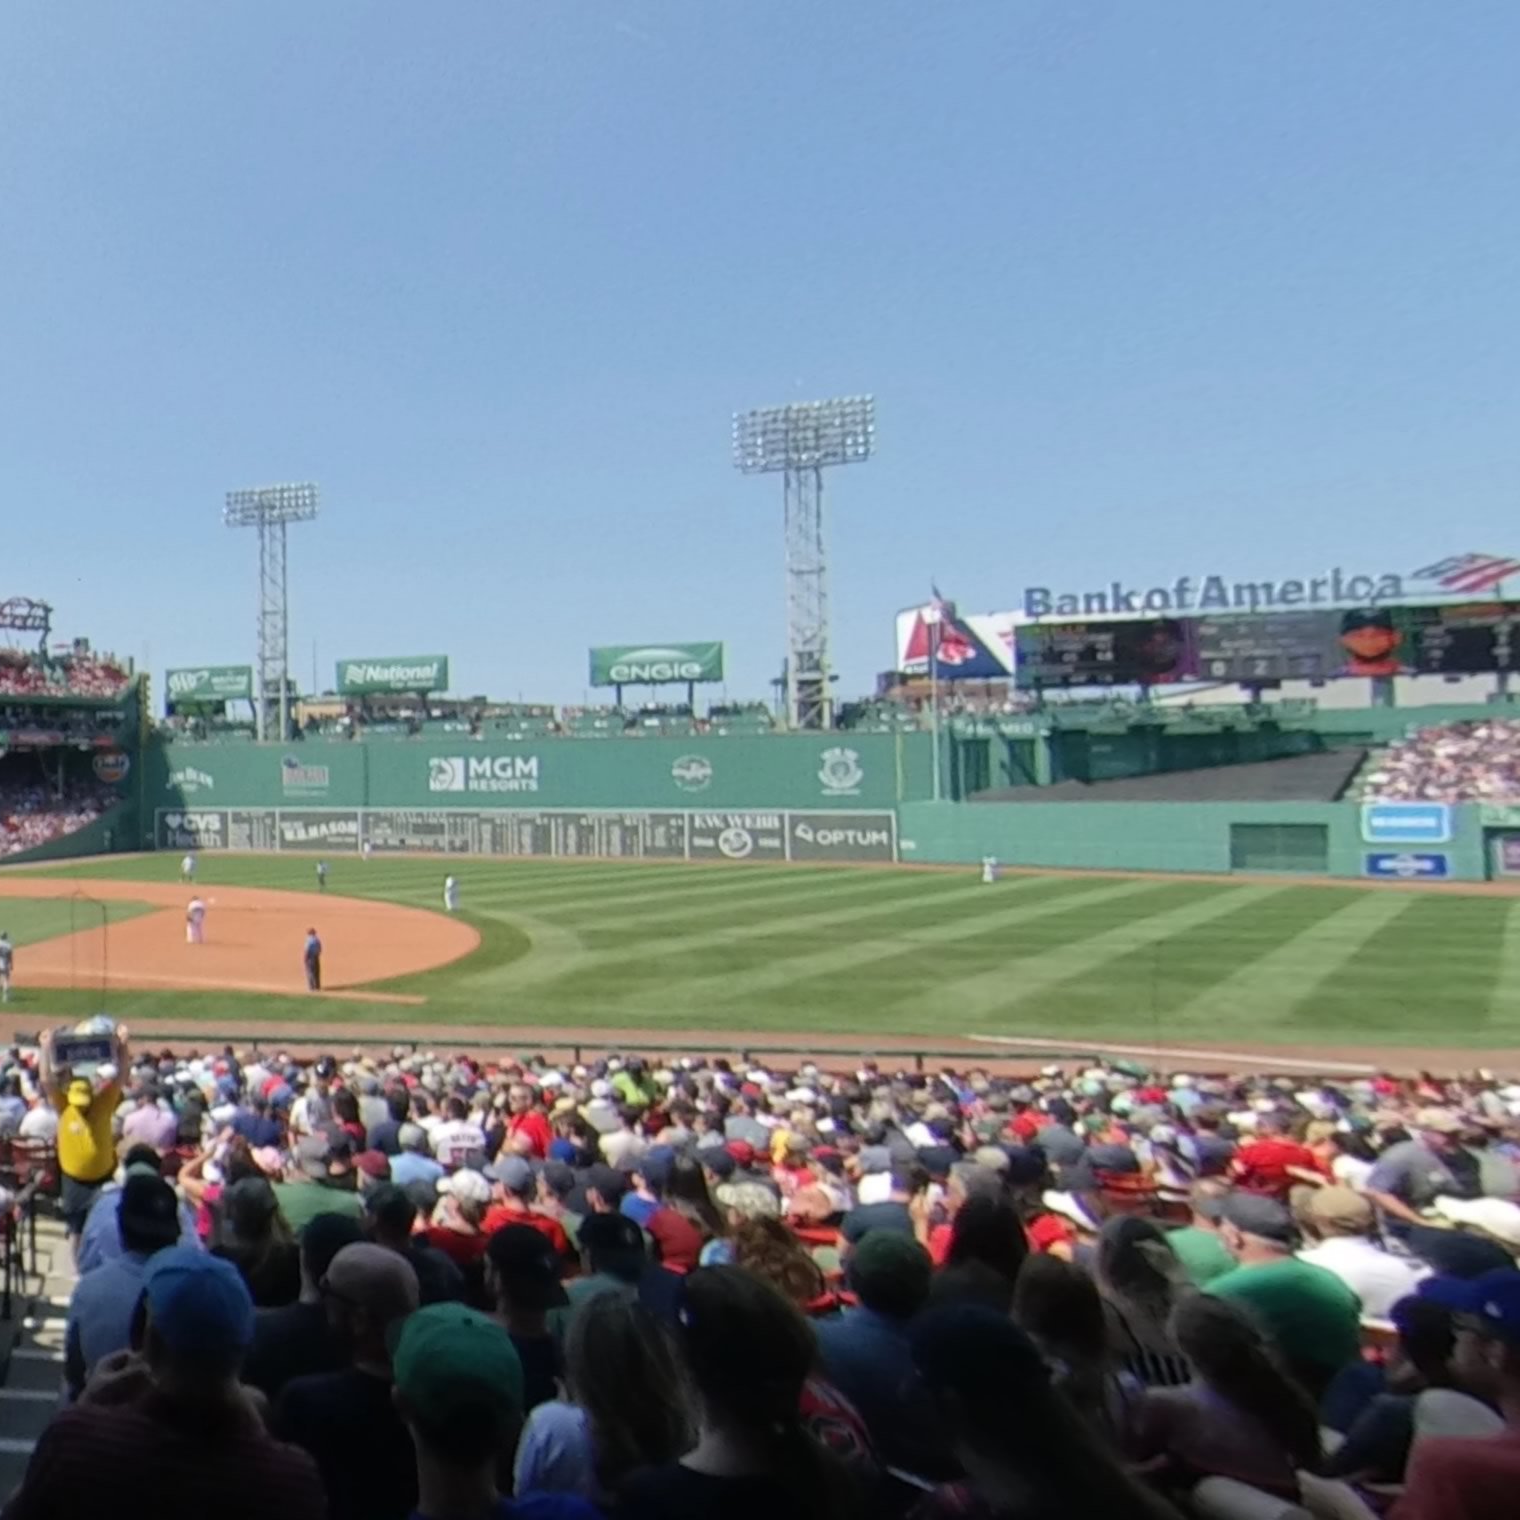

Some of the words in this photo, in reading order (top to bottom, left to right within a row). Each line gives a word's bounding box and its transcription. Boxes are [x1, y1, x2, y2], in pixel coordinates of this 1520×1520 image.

[1024, 582, 1136, 617] Bank
[1144, 577, 1191, 610] of
[1198, 567, 1403, 607] America
[366, 662, 438, 681] National
[468, 756, 539, 778] MGM
[468, 779, 539, 791] RESORTS
[183, 813, 221, 831] CVS
[167, 831, 221, 847] Health
[815, 829, 889, 846] OPTUM
